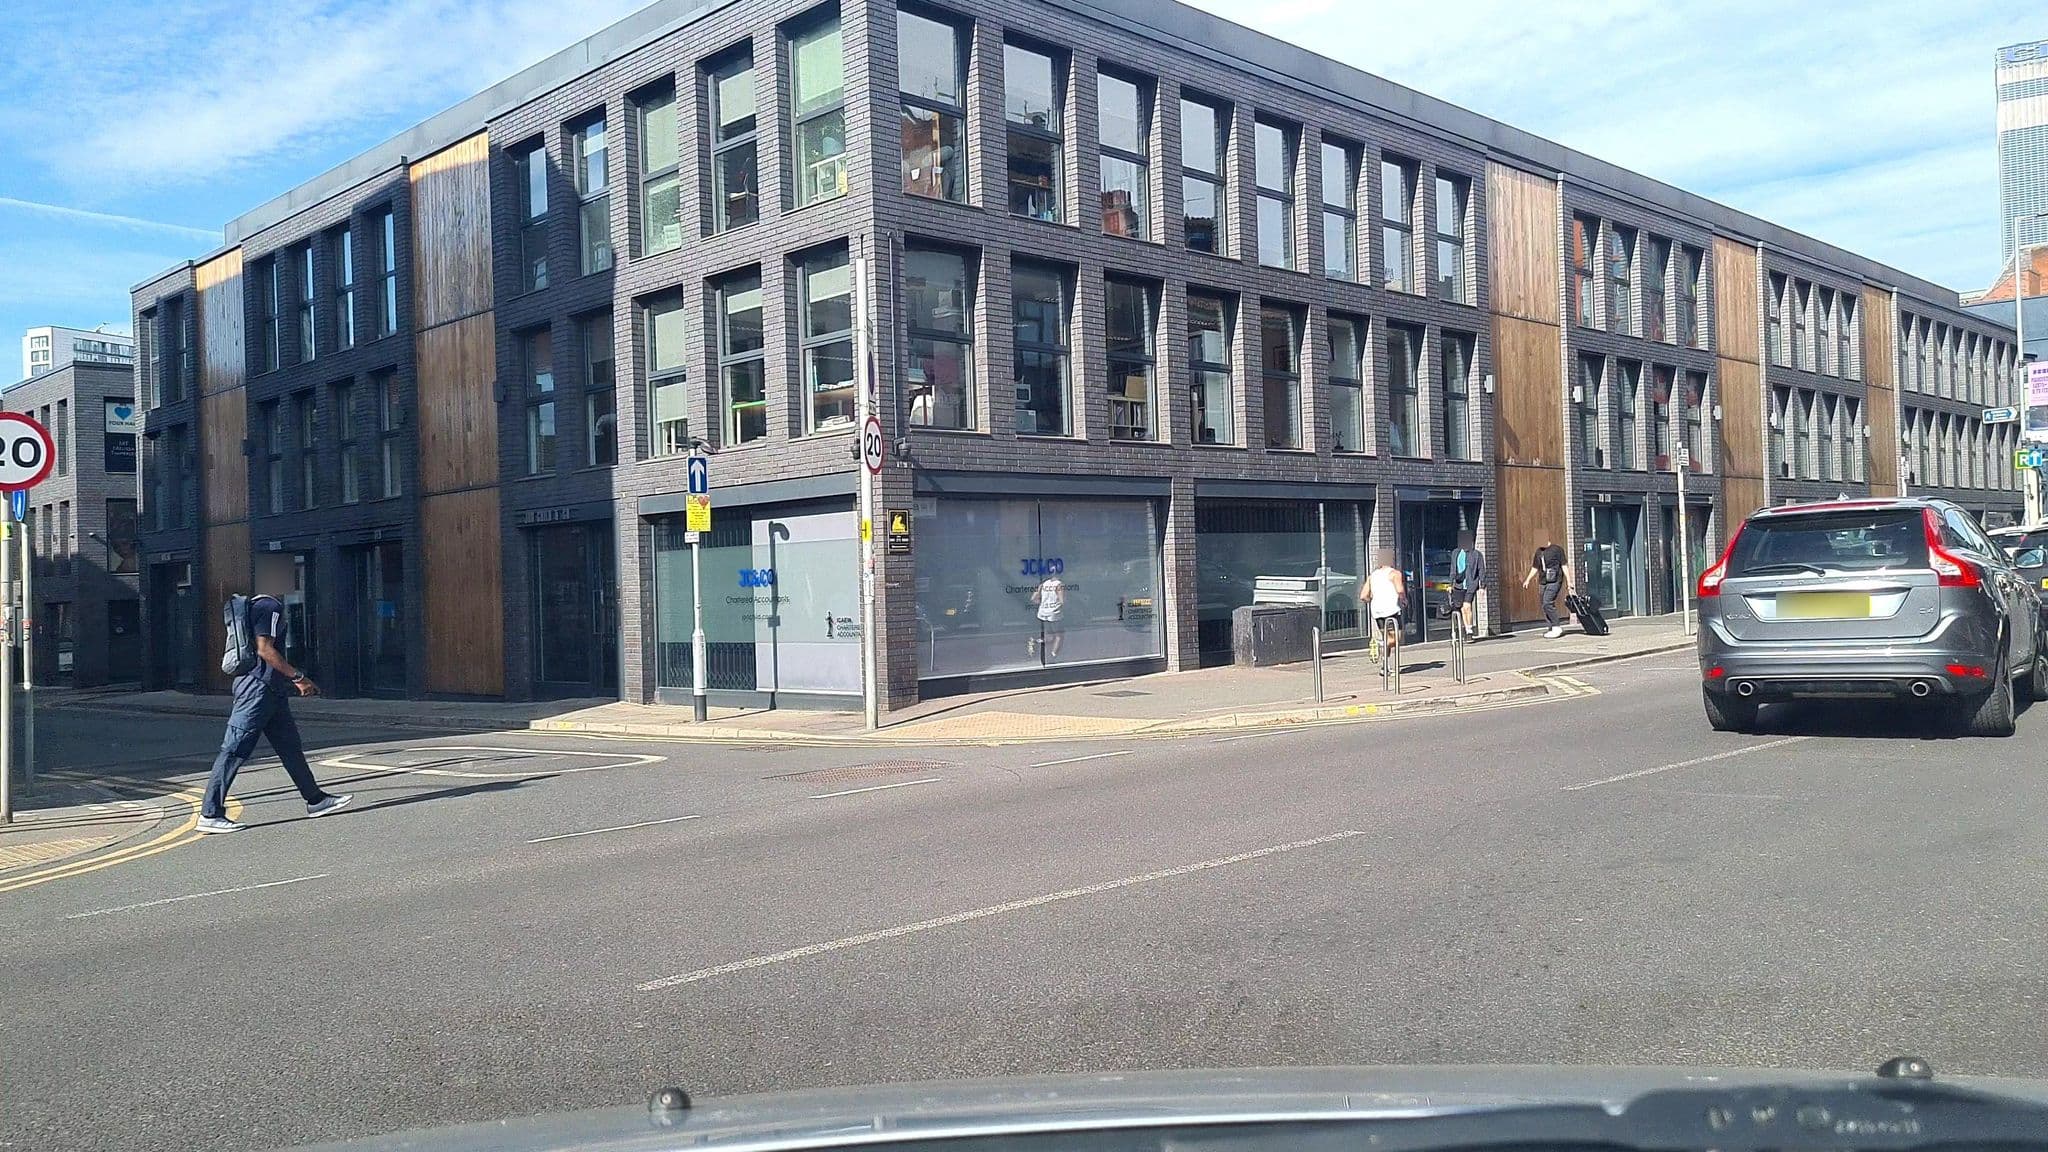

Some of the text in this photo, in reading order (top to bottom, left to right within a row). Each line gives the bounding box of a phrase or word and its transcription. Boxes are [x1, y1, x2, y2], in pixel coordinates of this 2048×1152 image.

[0, 436, 41, 468] 0
[866, 432, 881, 458] 20
[1005, 584, 1039, 594] Chartered
[725, 595, 753, 604] Chartered
